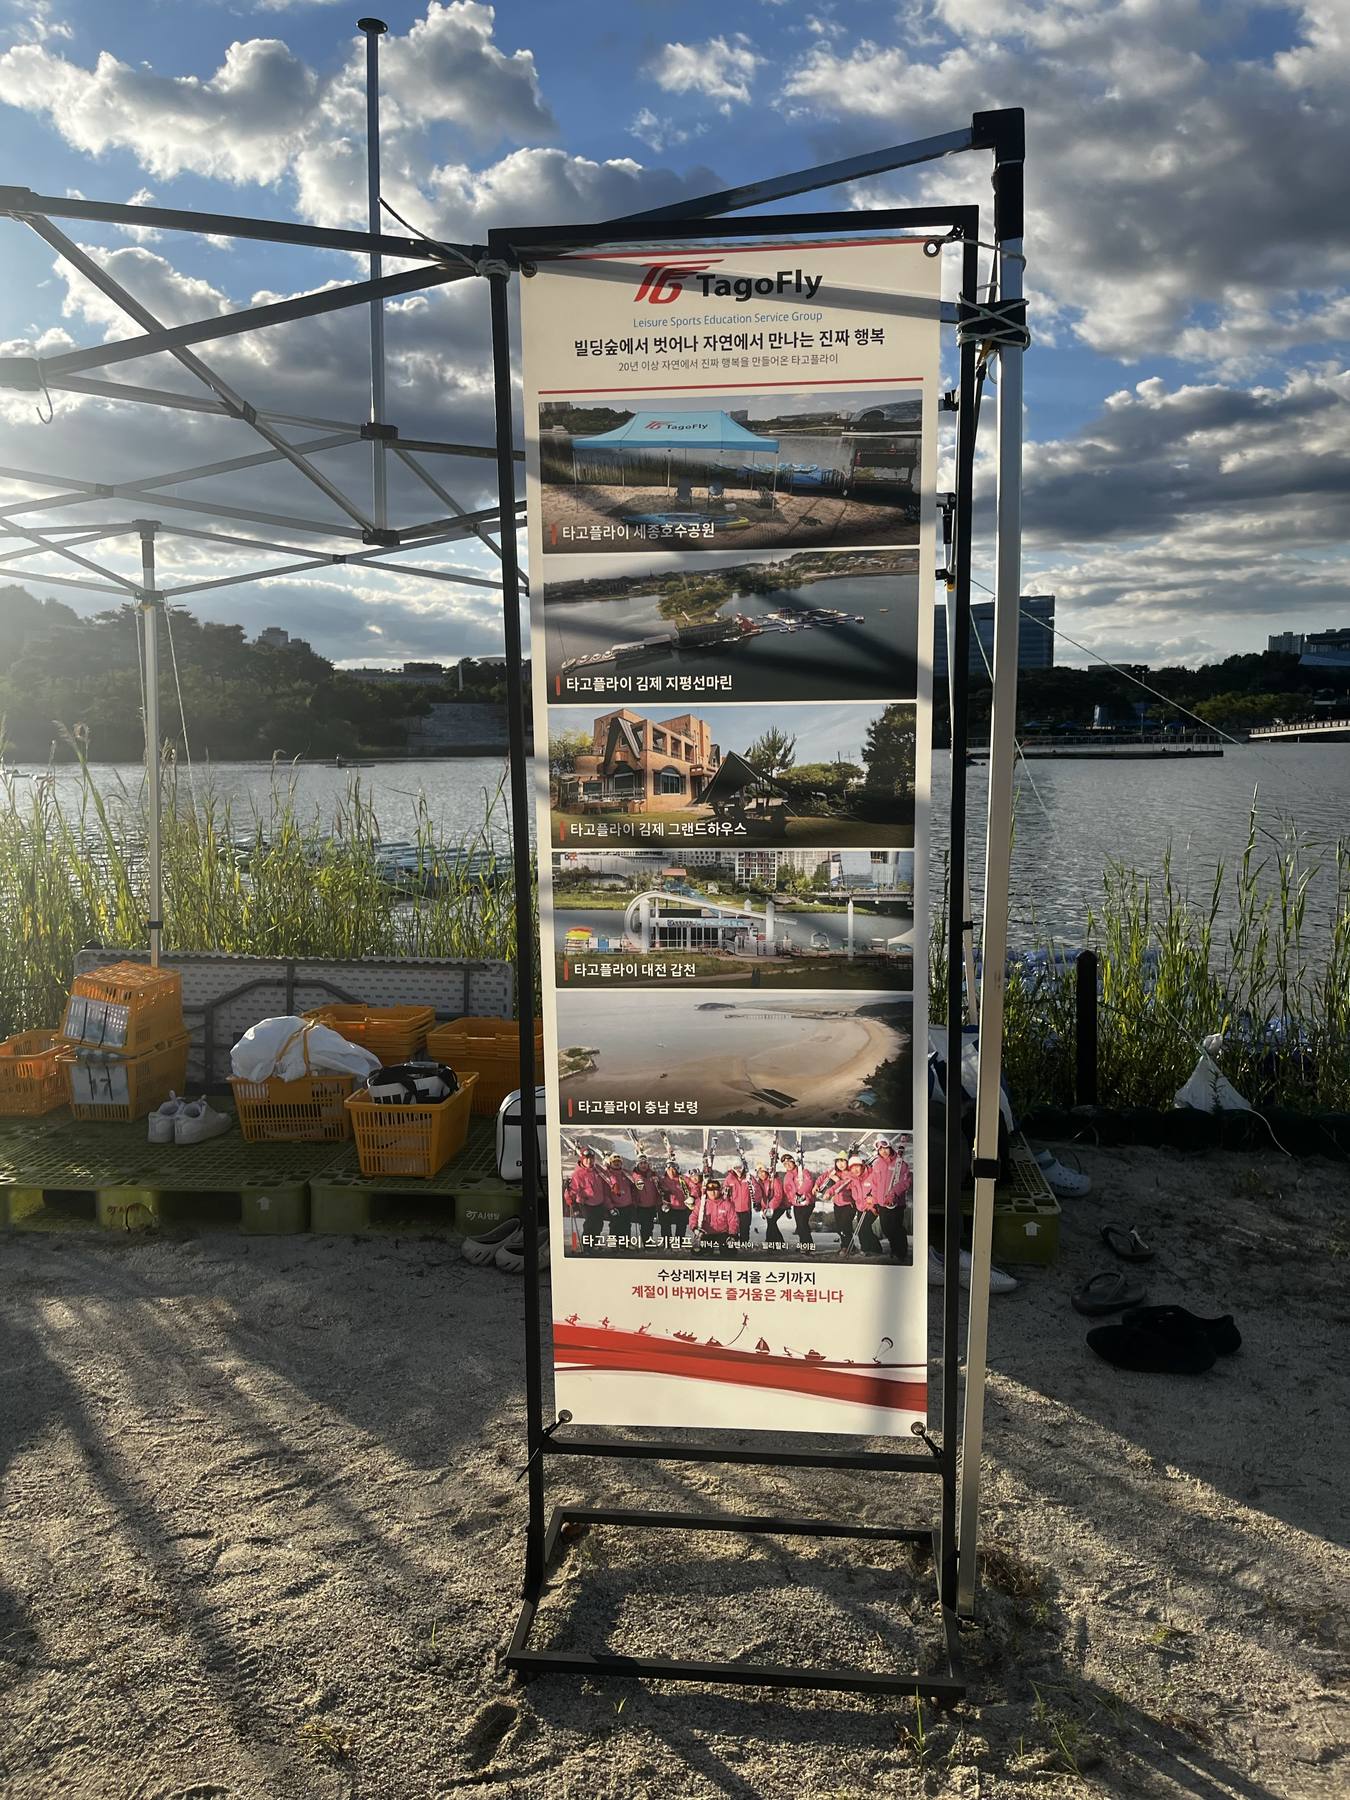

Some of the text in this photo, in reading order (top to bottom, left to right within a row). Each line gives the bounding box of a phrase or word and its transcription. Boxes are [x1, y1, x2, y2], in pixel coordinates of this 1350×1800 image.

[696, 269, 823, 302] TagoFly
[633, 311, 823, 328] Leisure Sports Education Service Group
[574, 327, 885, 357] 빌딩숲에서 벗어나 자연에서 만나는 진짜 행복
[618, 353, 838, 372] 20년 이상 자연에서 진짜 행복을 만들어온 타고플라이
[667, 423, 709, 431] TagoFly
[562, 522, 715, 541] 타고플라이 세종호수공원
[566, 674, 733, 692] 타고플라이 김제 지평선마린
[570, 822, 748, 837] 타고플라이 김제 그랜드하우스
[574, 963, 696, 977] 타고플라이 대전 갑천
[578, 1100, 698, 1115] 타고플라이 충남 보령
[582, 1234, 642, 1248] 타고플라이
[644, 1235, 693, 1249] 스키캠프
[657, 1268, 816, 1285] 수상레저부터 겨울 스키까지
[631, 1285, 844, 1303] 계절이 바뀌어도 즐거움은 계속됩니다
